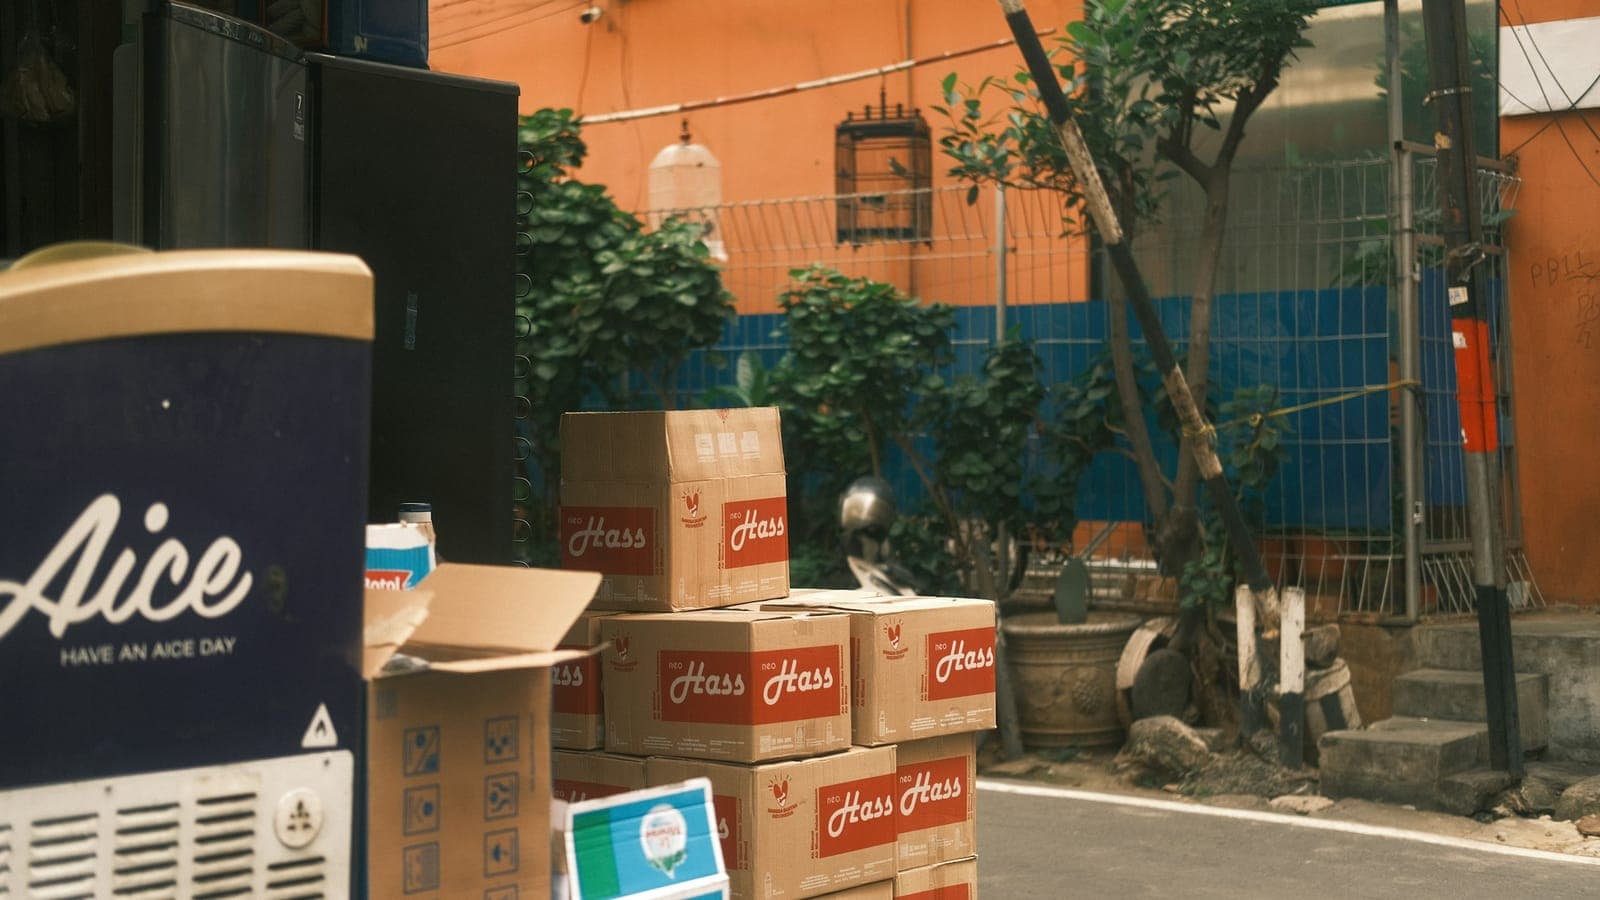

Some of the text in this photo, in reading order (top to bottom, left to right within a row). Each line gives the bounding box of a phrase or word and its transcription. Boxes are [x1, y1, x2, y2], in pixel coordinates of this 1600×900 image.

[568, 515, 646, 557] Hass
[730, 508, 785, 551] Hass
[0, 493, 253, 639] Aice
[60, 636, 236, 667] HAVE AN AICE DAY
[668, 661, 683, 671] neo
[761, 661, 776, 671] neo
[935, 642, 947, 651] neo
[935, 639, 994, 684] Hass
[552, 664, 584, 687] ass
[669, 660, 745, 705] Hass
[762, 659, 834, 706] Hass
[826, 795, 841, 805] neo
[827, 790, 894, 839] Hass
[899, 770, 962, 817] neo Hass
